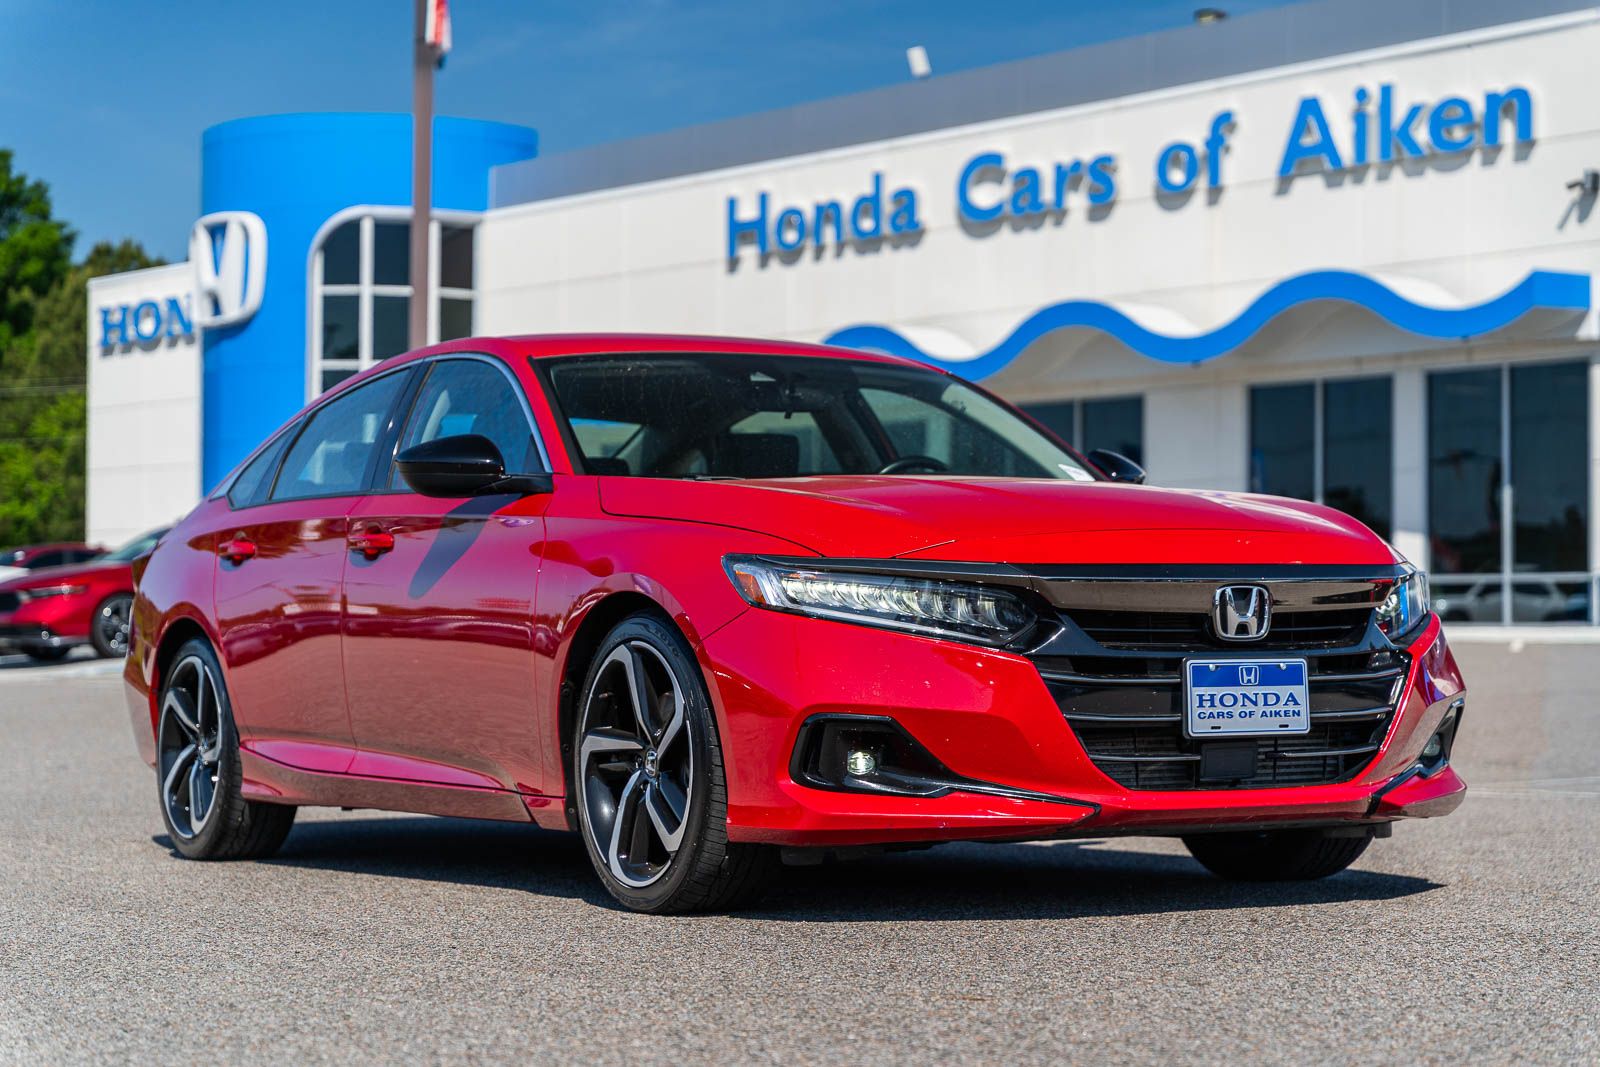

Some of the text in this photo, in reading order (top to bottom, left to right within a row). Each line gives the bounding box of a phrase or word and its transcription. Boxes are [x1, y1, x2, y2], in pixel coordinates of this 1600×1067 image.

[726, 84, 1533, 260] Honda Cars of Aiken
[1196, 692, 1301, 708] HONDA
[1197, 709, 1301, 720] CARS OF AIKEN
